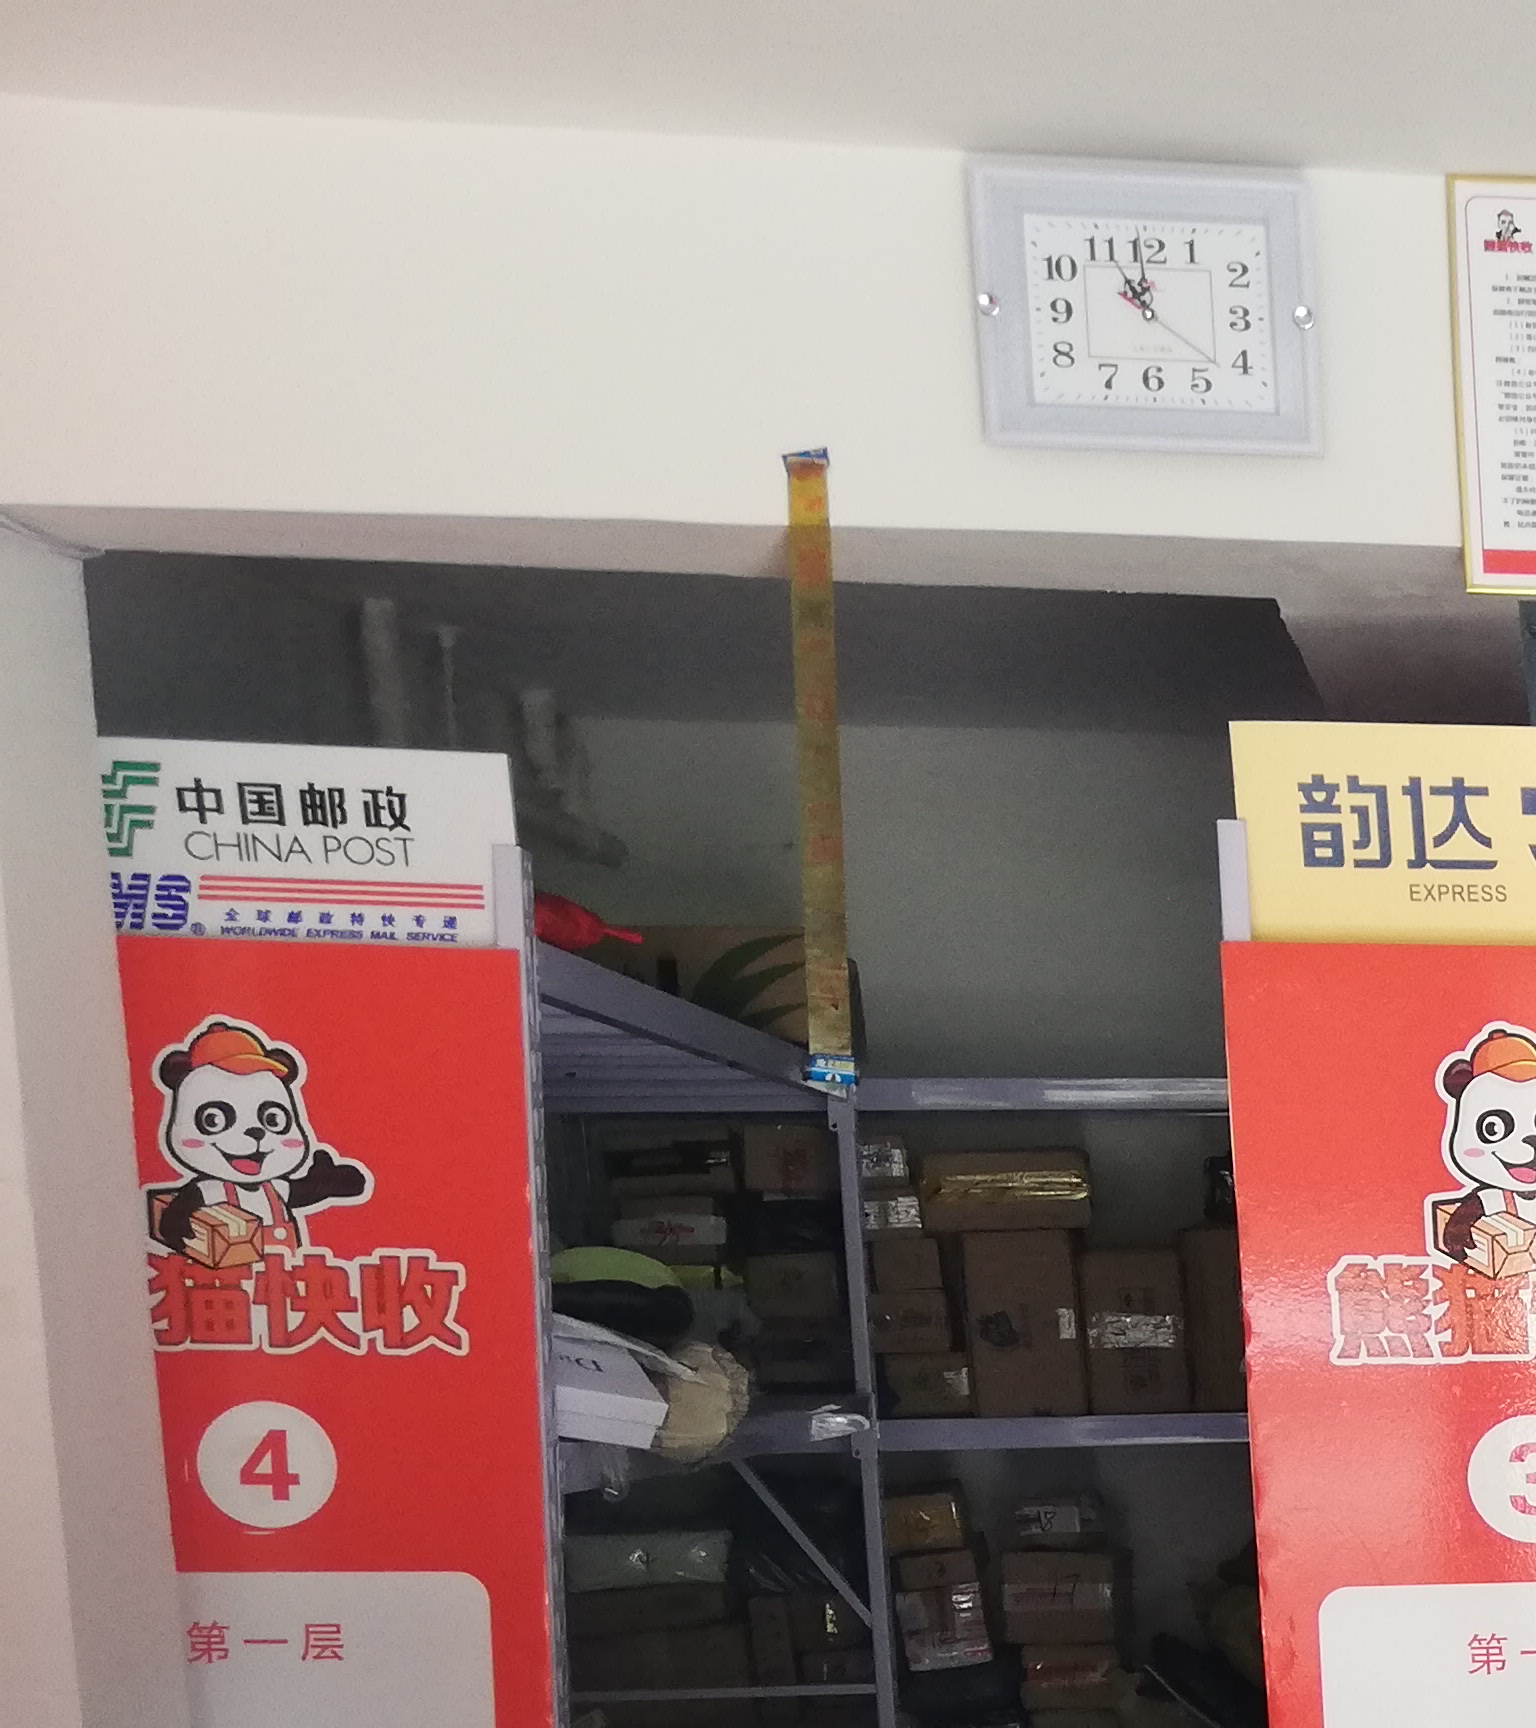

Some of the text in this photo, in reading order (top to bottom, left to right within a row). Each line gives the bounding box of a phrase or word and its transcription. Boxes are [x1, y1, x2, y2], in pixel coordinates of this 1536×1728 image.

[1084, 236, 1117, 263] 11
[1127, 236, 1167, 265] 12
[1184, 238, 1200, 265] 1
[1042, 254, 1079, 283] 10
[1226, 261, 1251, 289] 2
[1049, 297, 1074, 324] 9
[1229, 305, 1252, 332] 3
[1052, 340, 1076, 369] 8
[1231, 349, 1254, 376] 4
[1098, 363, 1119, 390] 7
[1142, 365, 1166, 393] 6
[1190, 367, 1213, 395] 5
[174, 776, 412, 833] 中国邮政
[1297, 773, 1499, 871] 韵达
[183, 830, 415, 868] CHINA POST
[1408, 882, 1508, 904] EXPRESS
[220, 924, 298, 938] WORLDWIDE
[305, 926, 363, 940] EXPRESS
[405, 930, 458, 944] SERVICE
[239, 1429, 301, 1501] 4
[186, 1620, 346, 1665] 第一层
